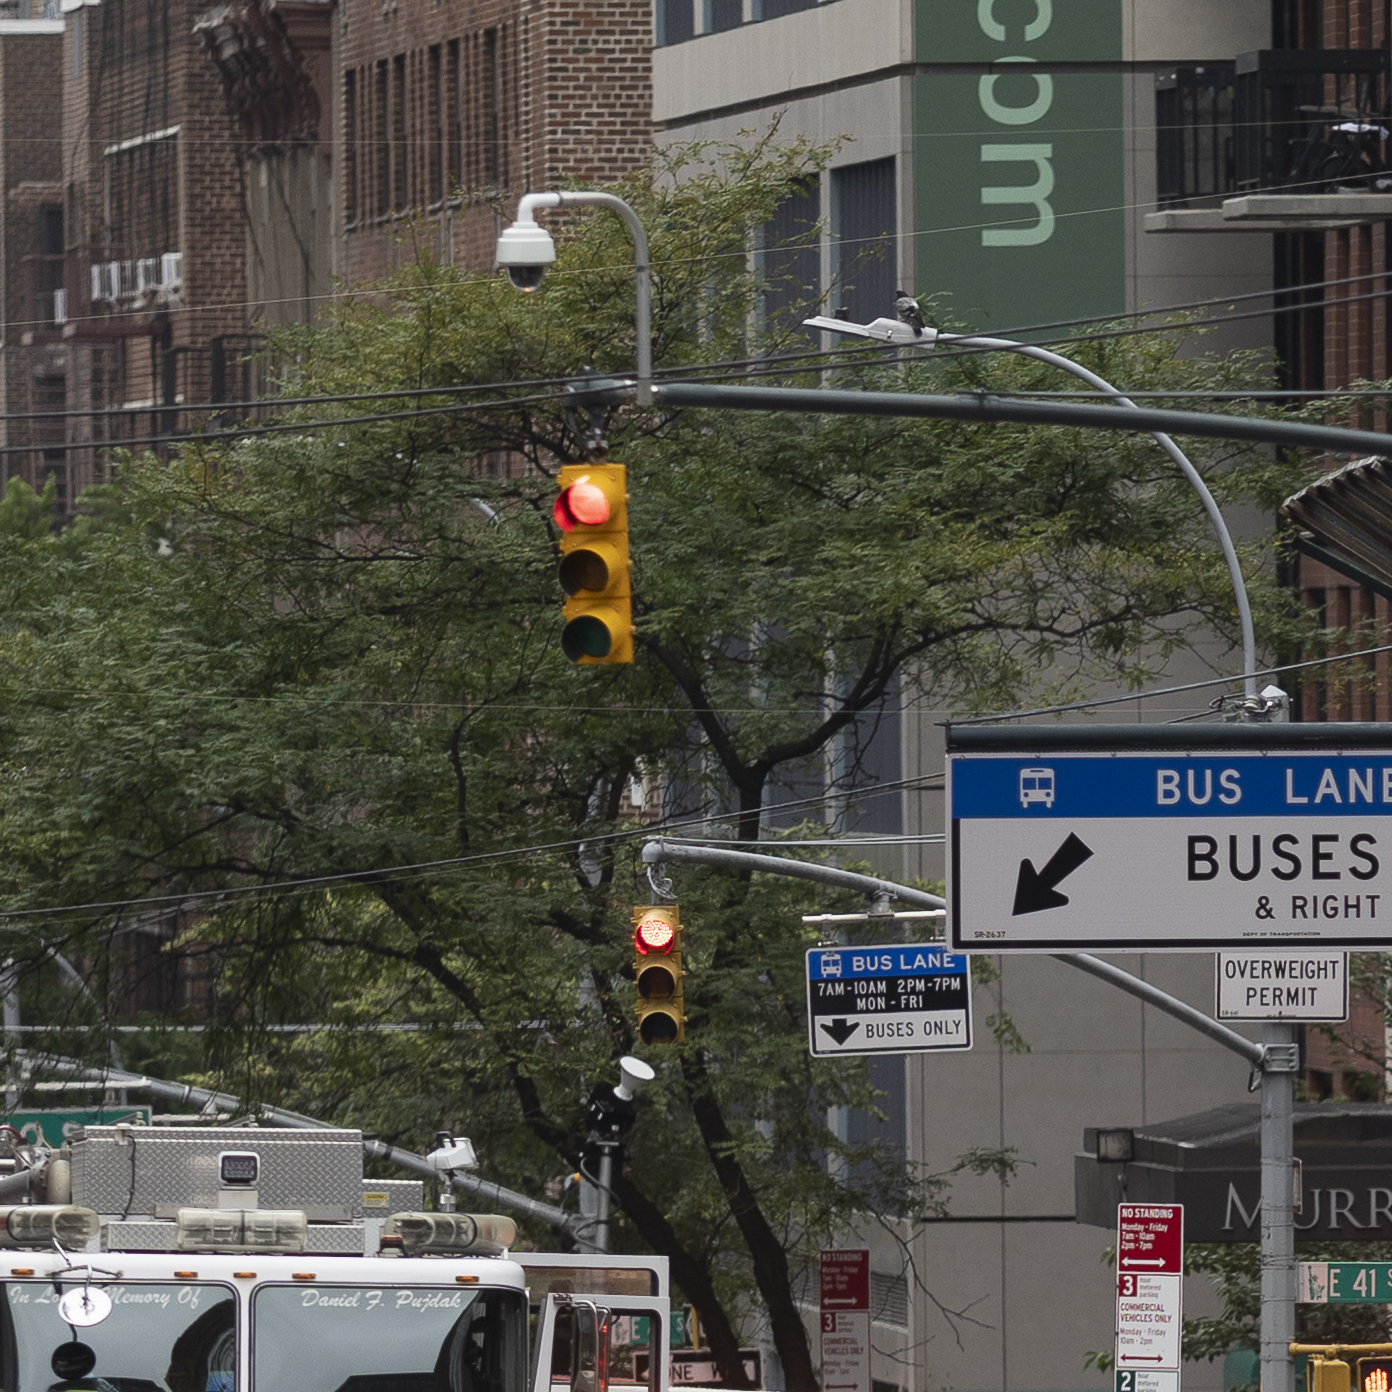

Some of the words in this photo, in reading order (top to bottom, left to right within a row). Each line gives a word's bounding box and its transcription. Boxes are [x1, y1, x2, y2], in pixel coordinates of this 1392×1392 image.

[1156, 768, 1242, 805] BUS
[1187, 831, 1380, 881] BUSES
[1254, 895, 1276, 920] &
[1292, 894, 1381, 920] RIGHT
[852, 955, 892, 972] BUS
[899, 953, 956, 970] LANE
[1225, 959, 1339, 980] OVERWEIGHT
[817, 980, 887, 996] 7AM-10AM
[897, 977, 960, 993] 2PM-7PM
[856, 997, 886, 1011] MON
[901, 995, 923, 1009] FRI
[1246, 987, 1318, 1007] PERMIT
[866, 1022, 915, 1039] BUSES
[923, 1019, 962, 1036] ONLY
[1122, 1208, 1133, 1218] NO
[1135, 1208, 1174, 1219] STANDING
[1122, 1275, 1134, 1296] 3
[1330, 1268, 1341, 1297] E
[1353, 1268, 1377, 1297] 41
[10, 1286, 31, 1304] In
[177, 1286, 201, 1310] Of
[301, 1288, 361, 1308] Daniel
[365, 1290, 385, 1311] F.
[395, 1290, 462, 1313] Pujdak
[1120, 1302, 1165, 1312] COMMERCIAL
[824, 1314, 833, 1331] 3
[1120, 1313, 1152, 1323] VEHICLES
[1154, 1314, 1172, 1323] ONLY
[1120, 1371, 1132, 1392] 2
